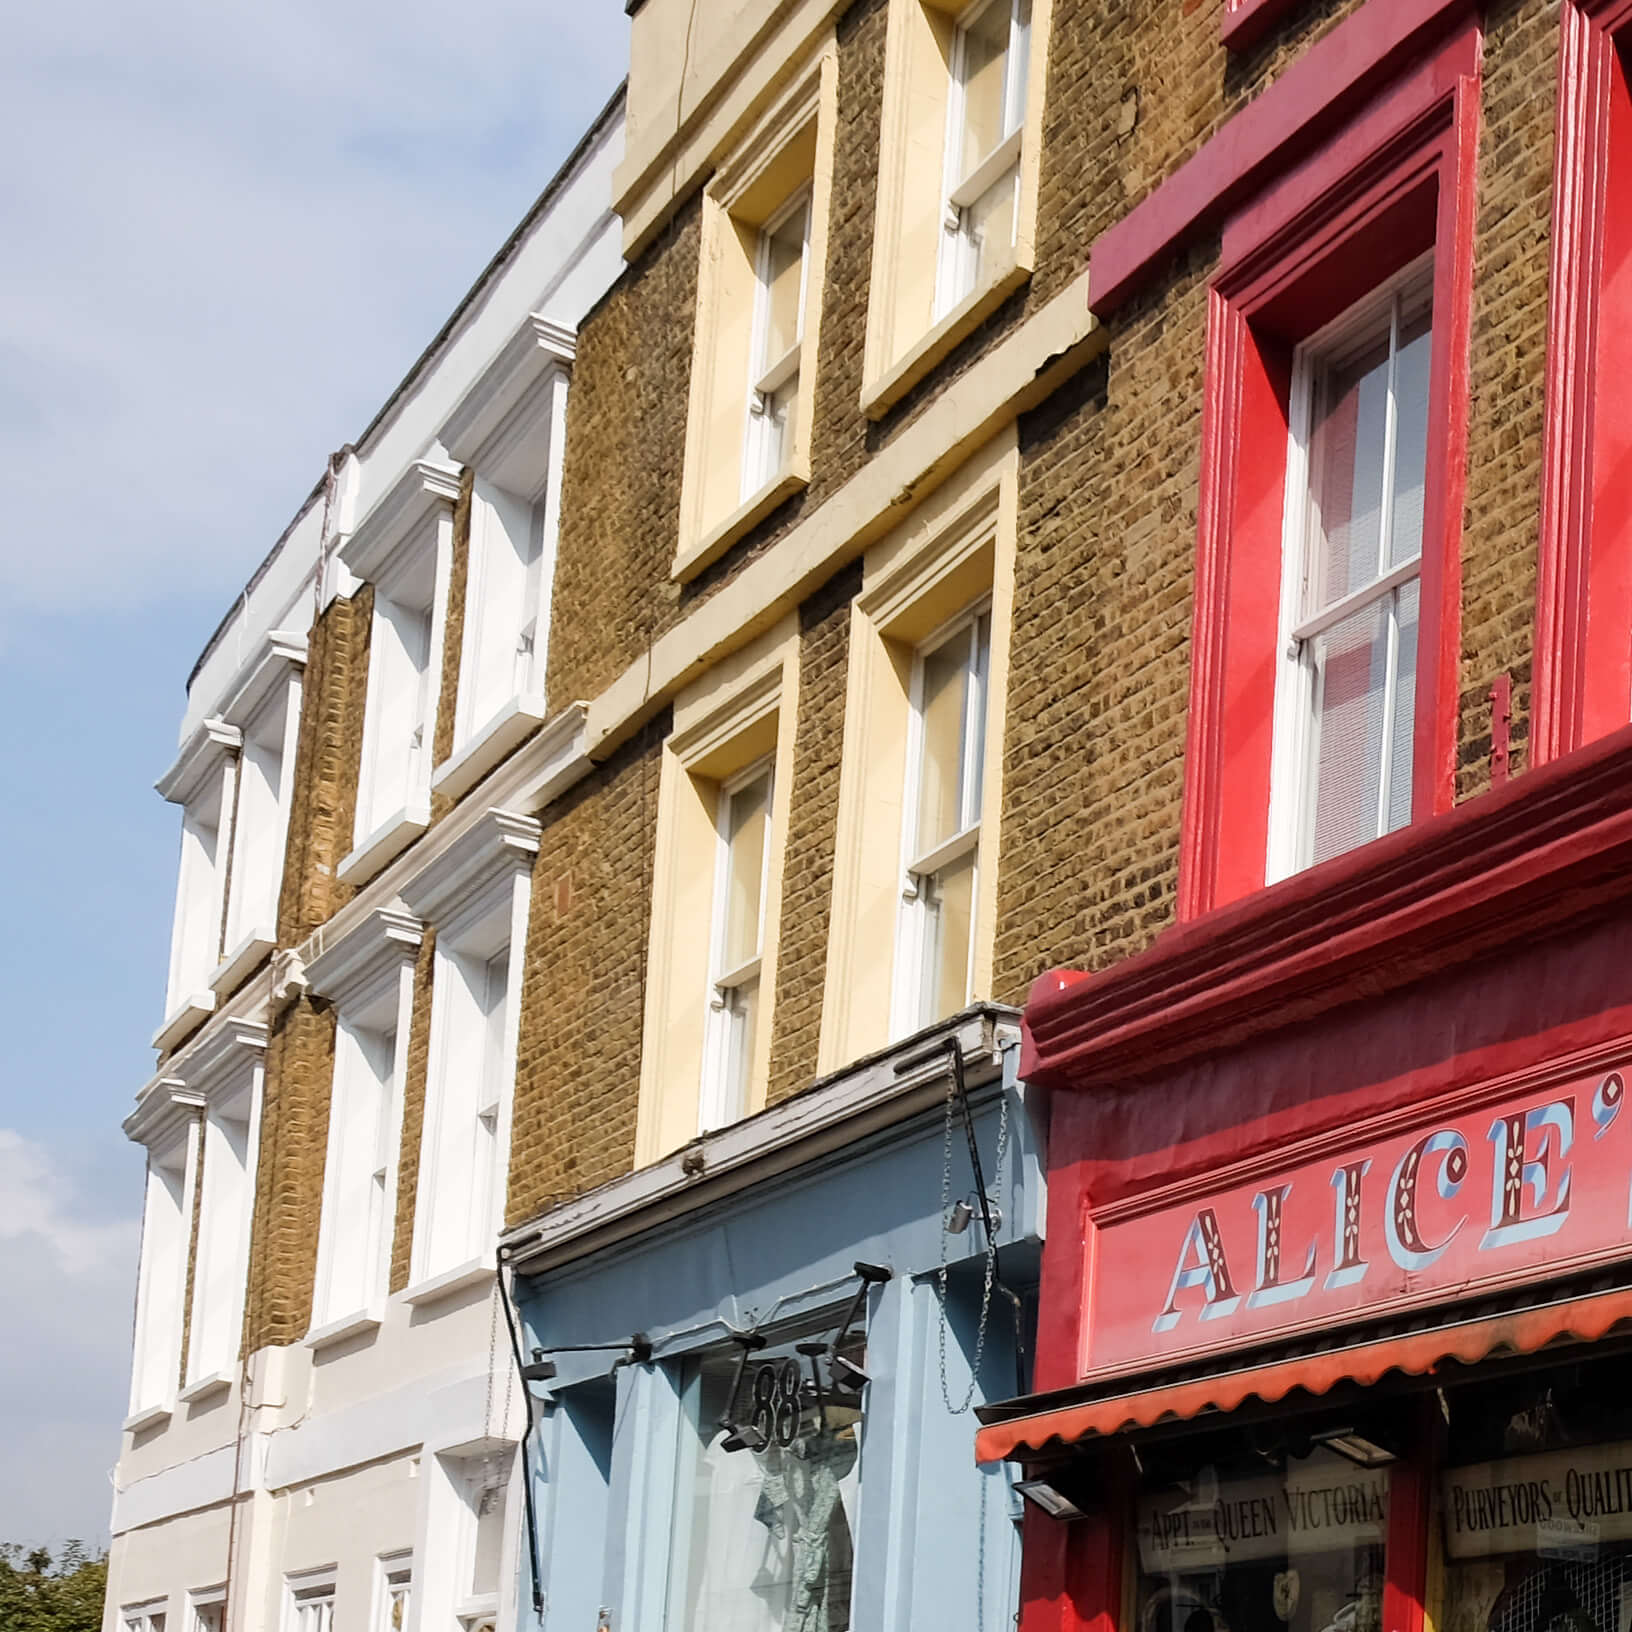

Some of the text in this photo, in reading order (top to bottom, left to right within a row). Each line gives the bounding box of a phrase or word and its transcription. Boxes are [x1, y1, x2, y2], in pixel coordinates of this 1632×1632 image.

[1214, 1479, 1385, 1553] QUEEN VICTORIA
[1453, 1479, 1553, 1534] PURVEYORS
